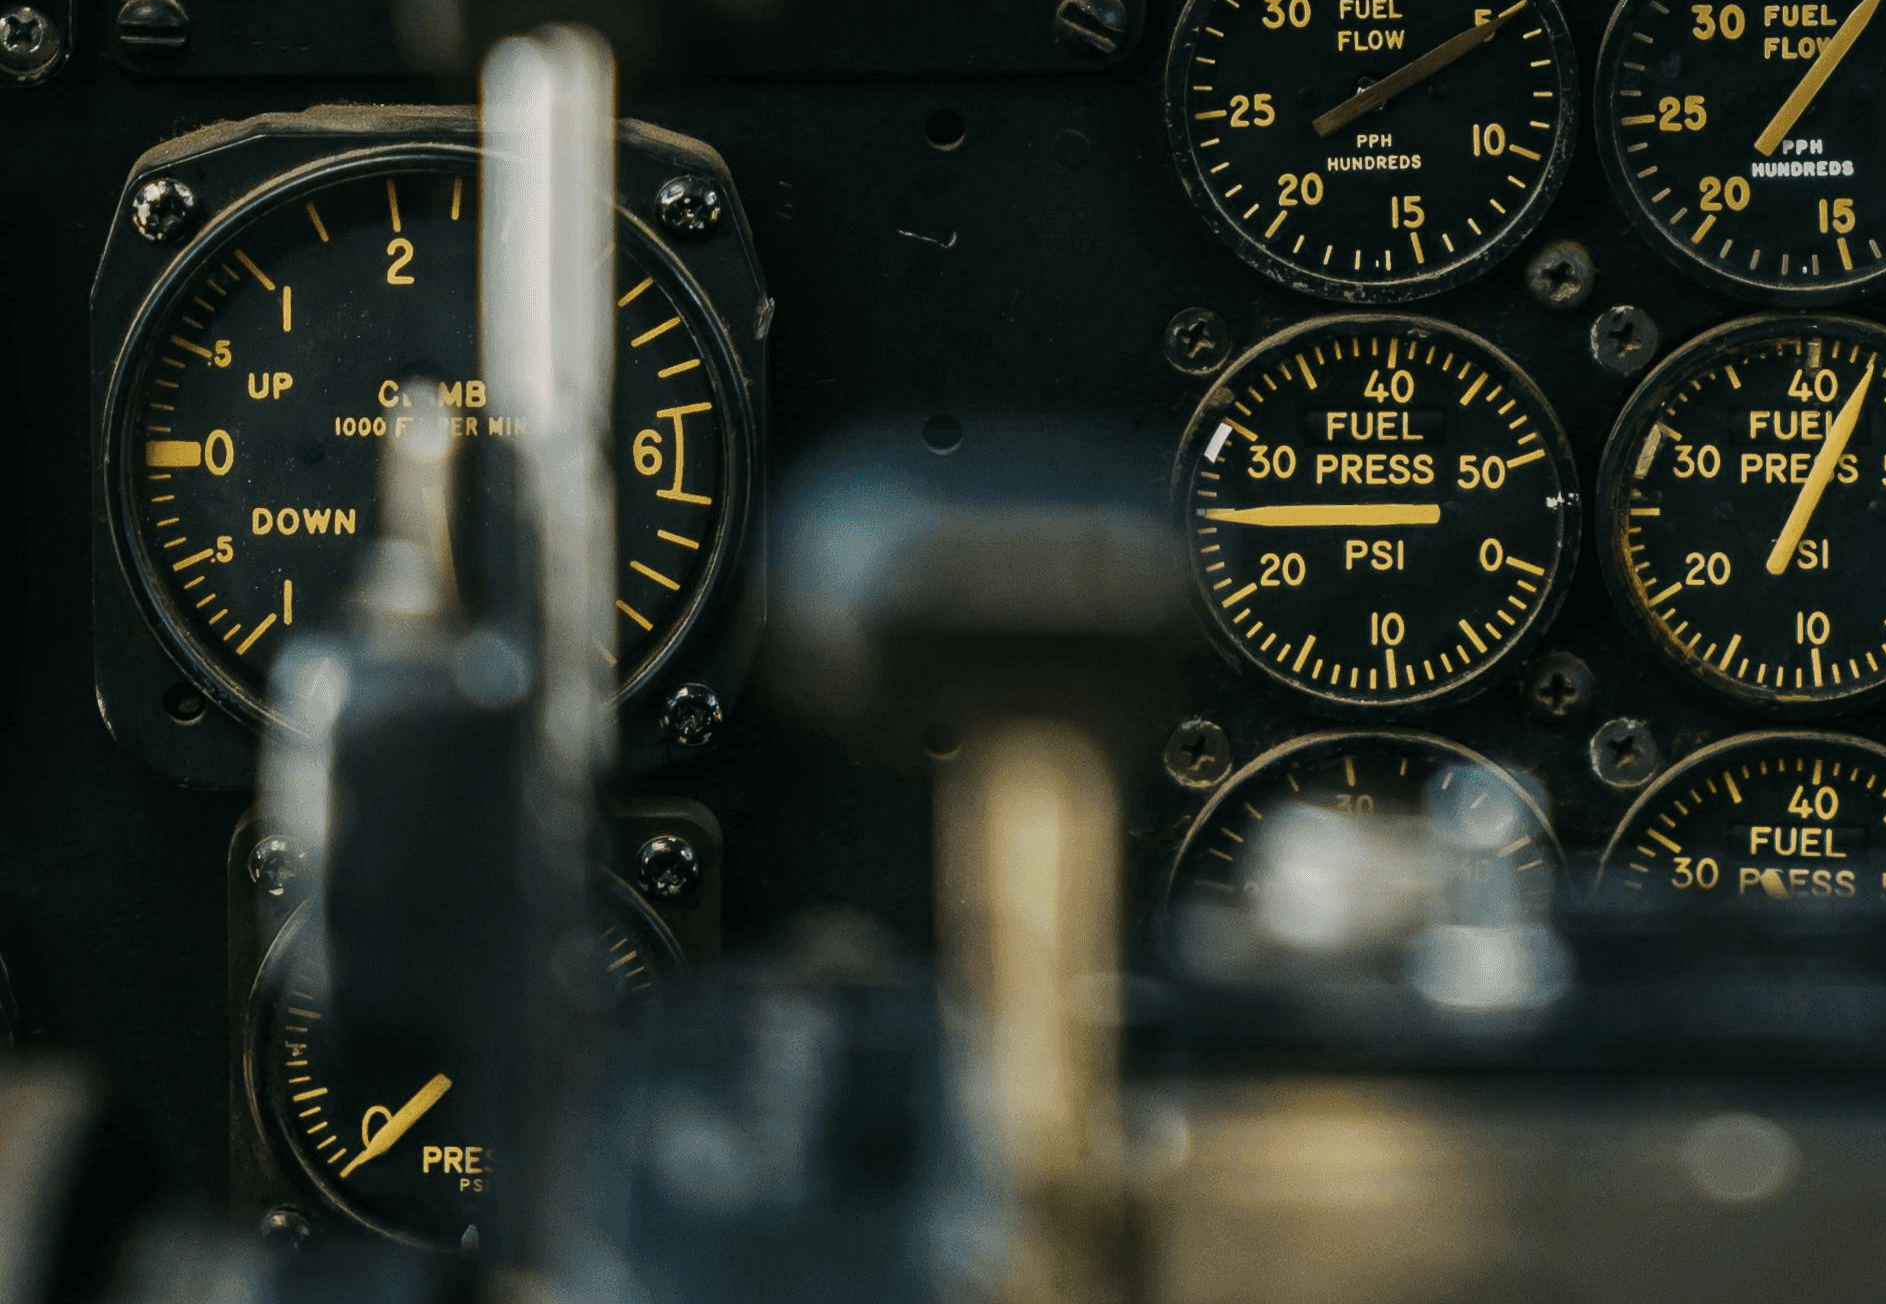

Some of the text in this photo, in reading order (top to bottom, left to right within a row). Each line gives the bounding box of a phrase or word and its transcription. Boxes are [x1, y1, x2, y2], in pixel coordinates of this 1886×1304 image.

[1763, 4, 1837, 28] FUEL
[1338, 30, 1405, 51] FLOW
[1230, 93, 1276, 128] 25
[1356, 133, 1392, 148] PPH
[1327, 155, 1422, 172] HUNDREDS
[1751, 160, 1854, 178] HUNDREDS
[1392, 195, 1425, 228] 15
[387, 238, 416, 285] 2
[247, 372, 294, 400] UP
[1363, 369, 1414, 404] 40
[1787, 369, 1839, 403] 40
[335, 416, 386, 437] 1000
[1326, 411, 1424, 441] FUEL
[632, 428, 663, 477] 6
[1247, 445, 1296, 479] 30
[1316, 454, 1434, 485] PRESS
[1457, 455, 1506, 490] 50
[250, 507, 357, 536] DOWN
[1260, 553, 1306, 587] 20
[1345, 539, 1404, 572] PSI
[1371, 611, 1404, 646] 10
[1748, 826, 1848, 859] FUEL
[1671, 856, 1720, 890] 30
